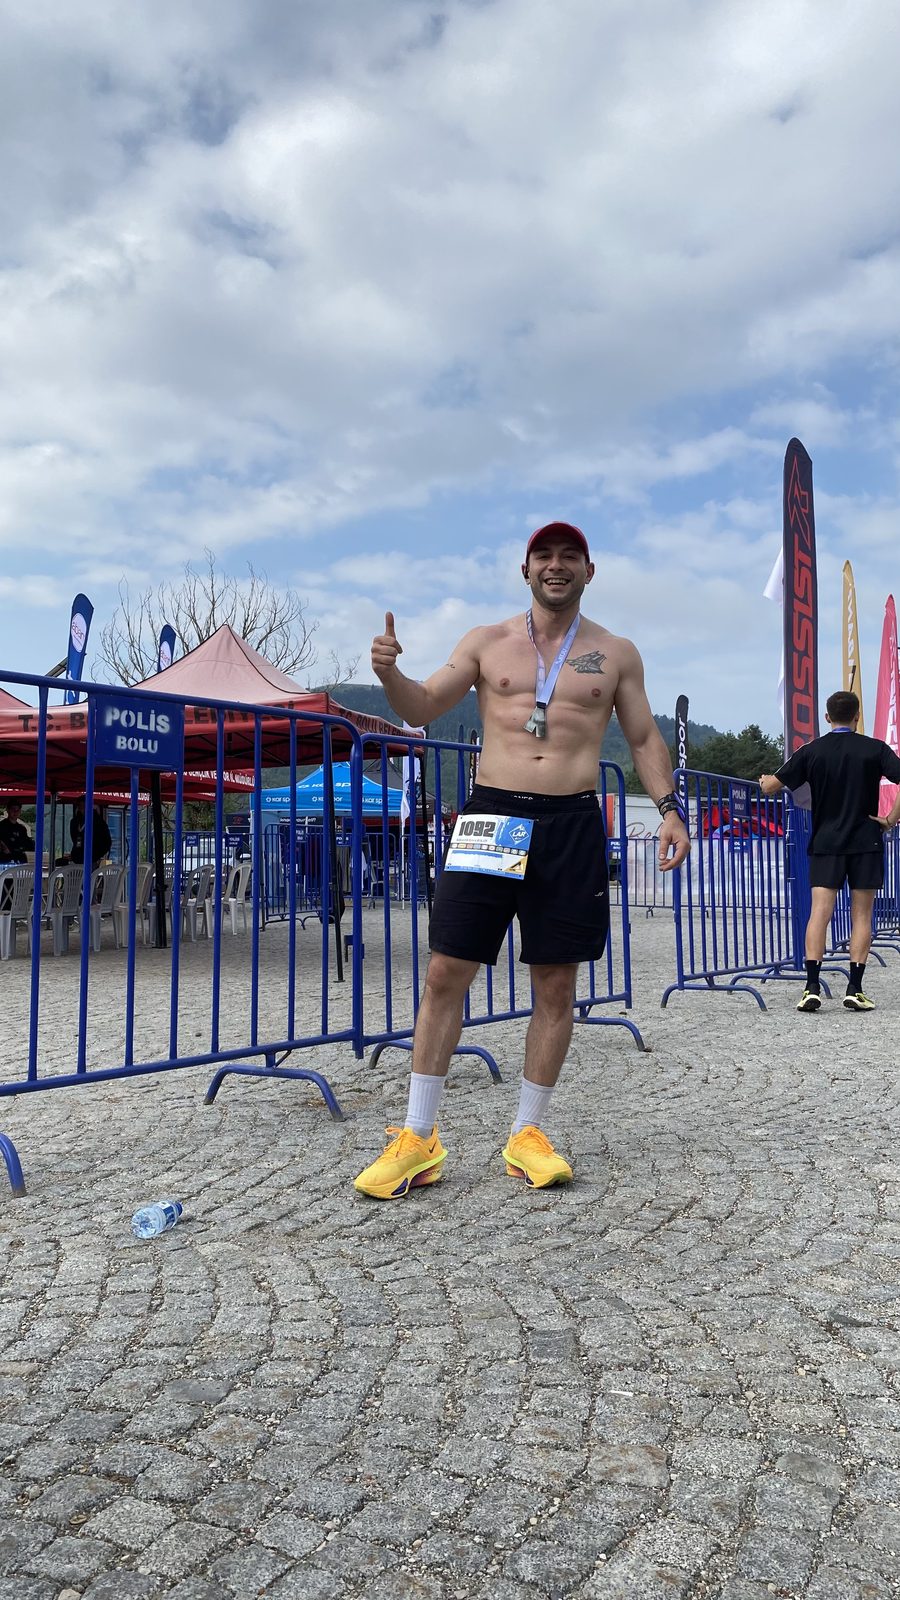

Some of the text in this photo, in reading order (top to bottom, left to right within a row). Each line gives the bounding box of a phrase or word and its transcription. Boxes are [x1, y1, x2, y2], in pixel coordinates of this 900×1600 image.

[104, 707, 171, 734] POLİS
[116, 735, 158, 753] BOLU
[458, 821, 496, 840] 1092
